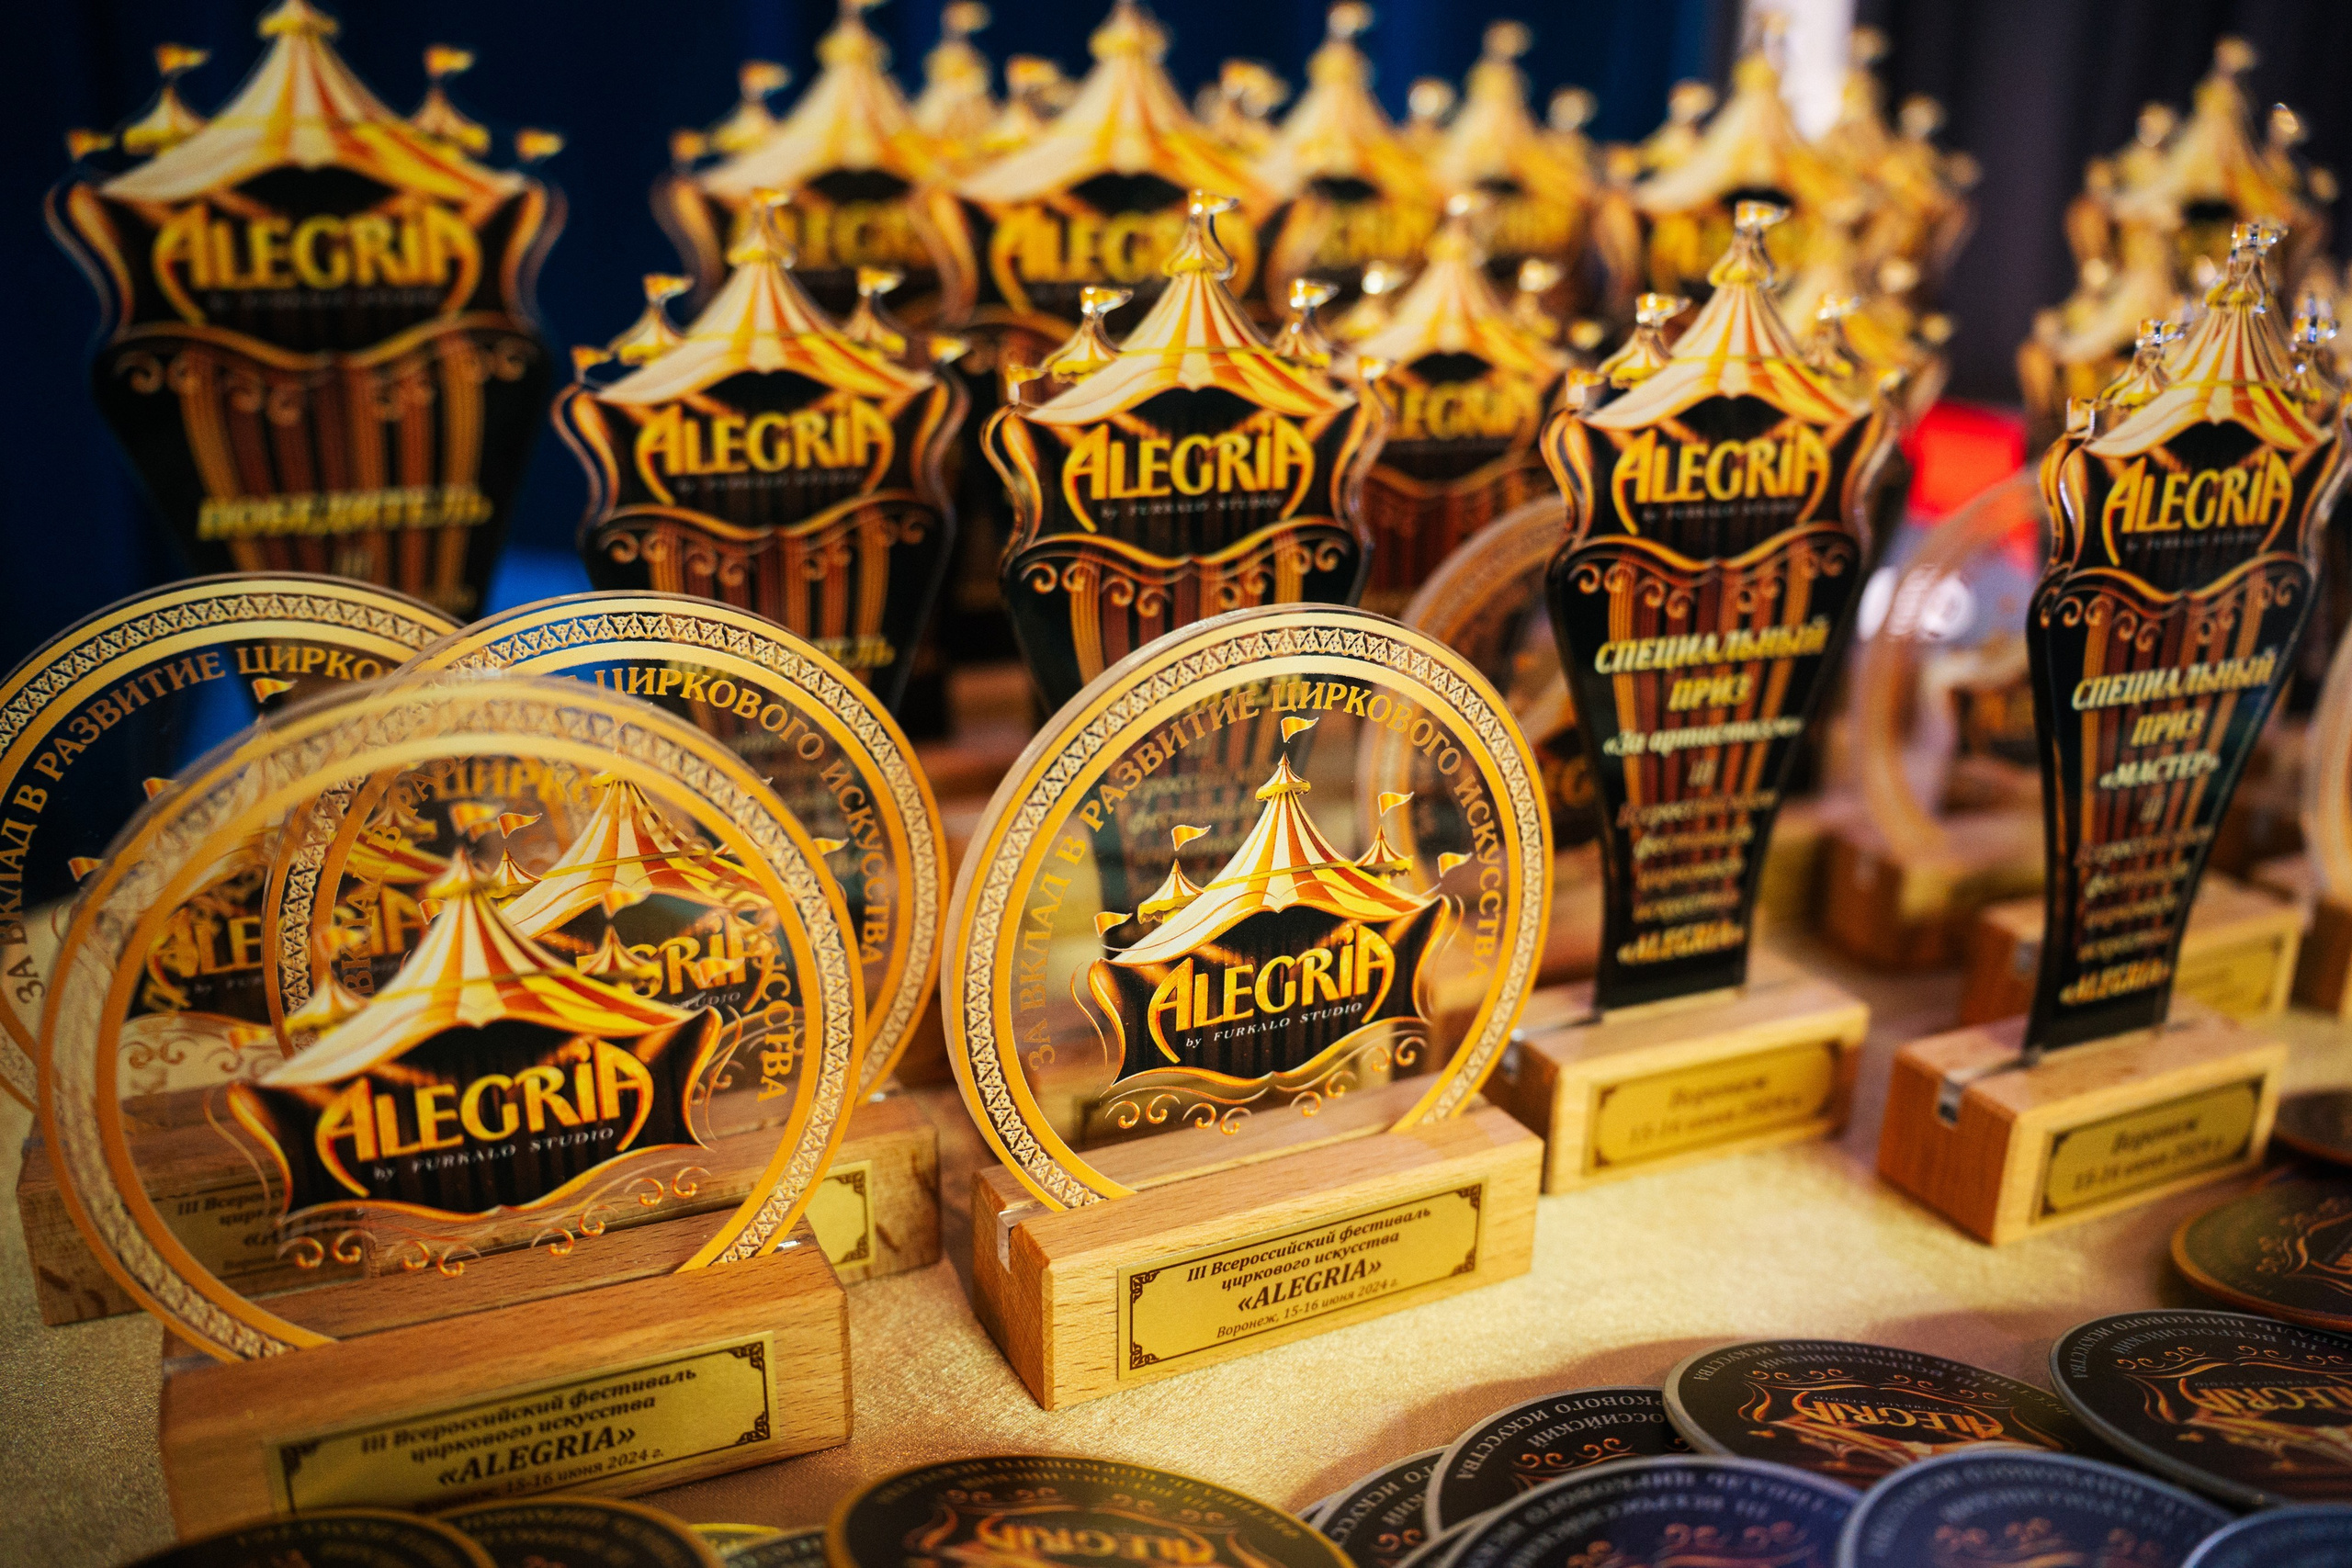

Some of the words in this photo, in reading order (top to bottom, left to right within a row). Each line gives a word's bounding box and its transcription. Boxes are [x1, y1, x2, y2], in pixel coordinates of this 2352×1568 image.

[237, 646, 397, 682] ЦИРКО
[1595, 615, 1829, 674] СПЕЦИАЛЬНЫЙ
[1668, 672, 1753, 712] ПРИЗ
[2072, 647, 2277, 710] СПЕЦИАЛЬНЫЙ
[33, 652, 225, 783] РАЗВИТИЕ
[1271, 682, 1463, 775] ЦИРКОВОГО
[2131, 707, 2205, 747] ПРИЗ
[1079, 690, 1260, 832] РАЗВИТИЕ
[13, 784, 48, 813] В
[595, 667, 826, 761] ЦИРКОВОГО
[821, 759, 890, 966] ИСКУССТВА
[1055, 836, 1087, 866] В
[1453, 773, 1504, 981] ИСКУССТВА
[1019, 872, 1071, 1011] ВКЛАД
[7, 954, 45, 1004] ЗА
[1023, 1018, 1056, 1071] ЗА
[1185, 1036, 1202, 1048] by
[1214, 1017, 1291, 1043] FURKALO
[1300, 1002, 1363, 1023] STUDIO
[529, 1126, 614, 1153] STUDIO
[1187, 1265, 1206, 1282] III
[1210, 1232, 1335, 1276] Всероссийский
[1340, 1207, 1431, 1243] фестиваль
[1222, 1257, 1310, 1291] циркового
[1315, 1232, 1399, 1265] искусства
[1216, 1313, 1280, 1339] Воронеж,
[1284, 1299, 1318, 1319] 15-16
[1321, 1290, 1354, 1309] июня
[1358, 1280, 1388, 1300] 2024
[1238, 1258, 1382, 1313] «ALEGRIA»
[2110, 1329, 2277, 1356] ВСЕРОССИЙСКИЙ
[2112, 1315, 2245, 1331] ЦИРКОВОГО
[1692, 1345, 1772, 1382] ИСКУССТВА
[2069, 1326, 2112, 1378] ИСКУССТВА
[393, 1392, 564, 1449] Всероссийский
[568, 1369, 697, 1409] фестиваль
[411, 1424, 533, 1464] циркового
[537, 1395, 656, 1435] искусства
[1526, 1412, 1667, 1449] ОССИЙСКИЙ
[437, 1426, 637, 1487] «ALEGRIA»
[607, 1450, 648, 1472] 2024
[1456, 1409, 1549, 1480] ИСКУССТВА
